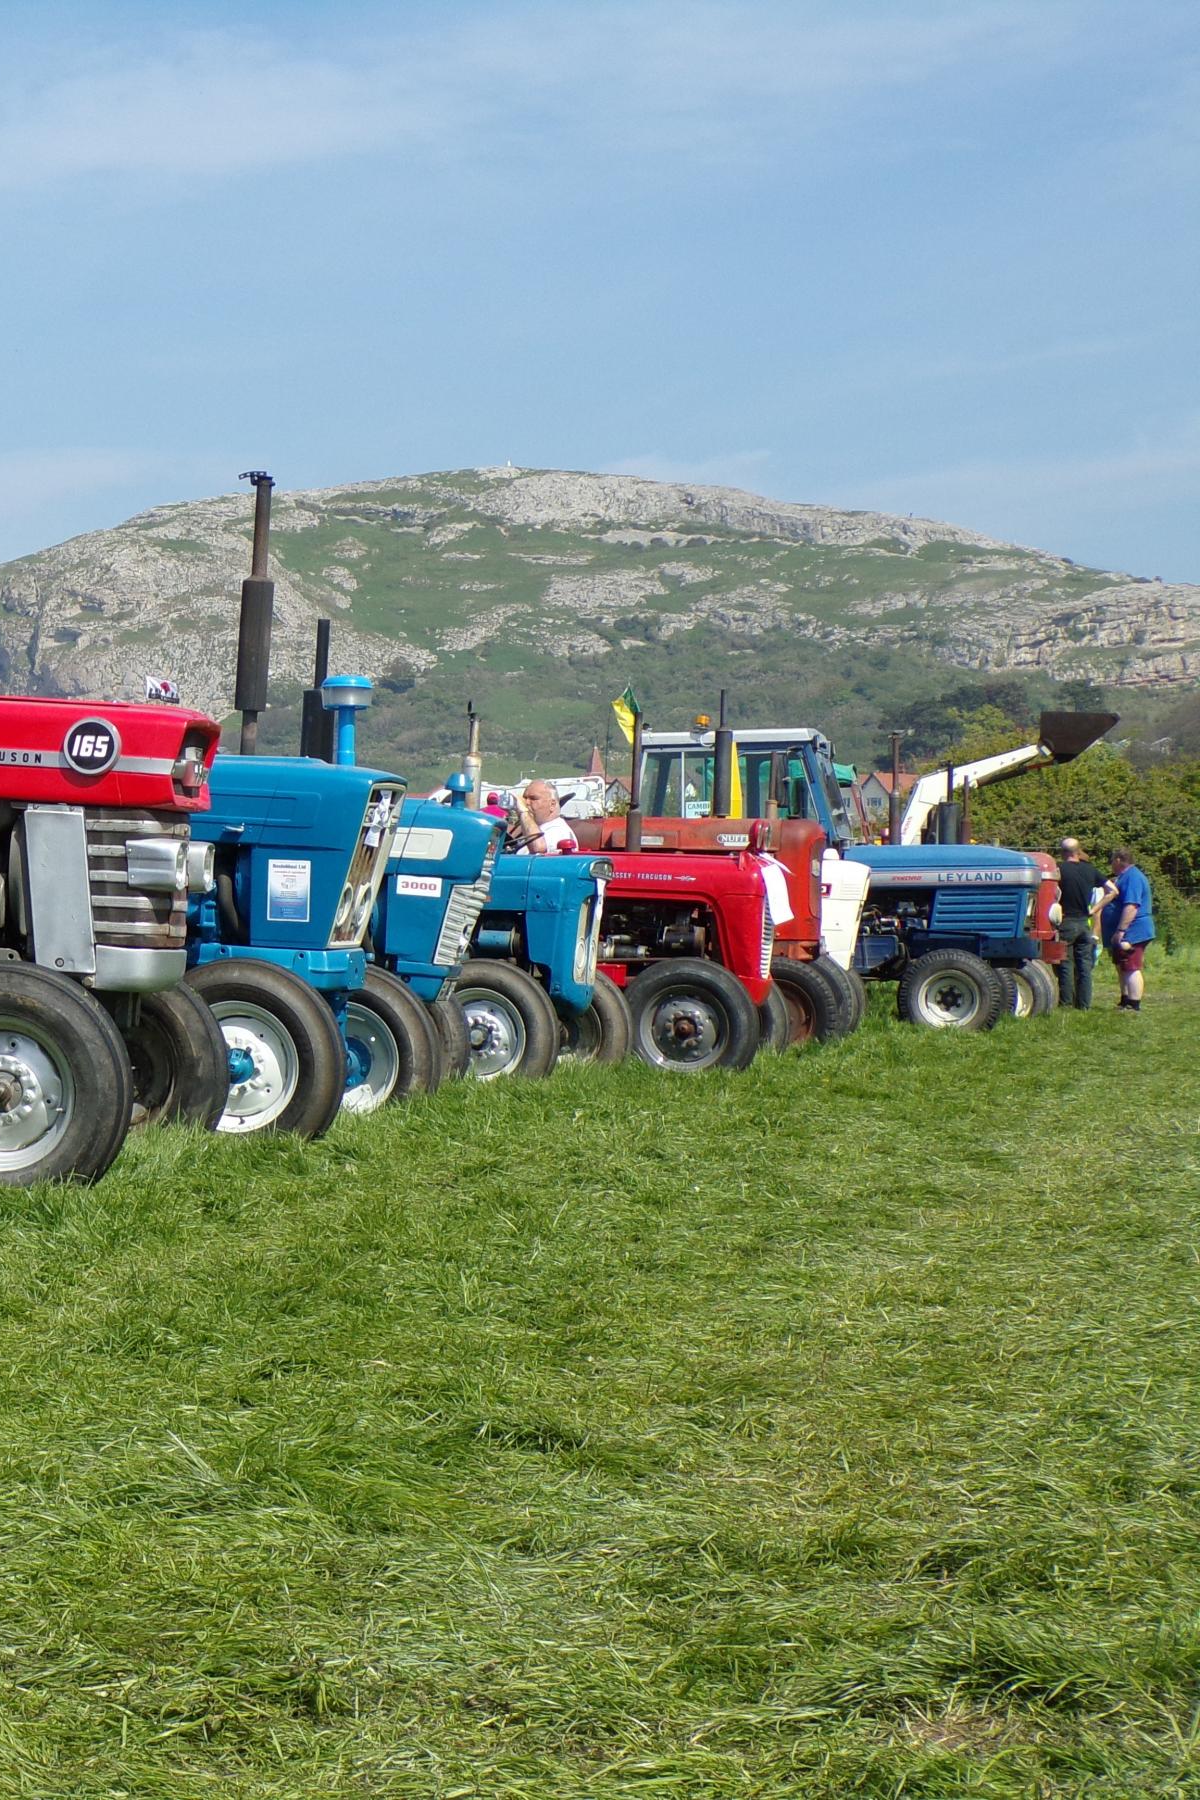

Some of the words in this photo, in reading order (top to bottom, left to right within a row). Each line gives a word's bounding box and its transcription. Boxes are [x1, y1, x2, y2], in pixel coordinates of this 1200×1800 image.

[71, 735, 110, 758] 165
[938, 872, 1003, 882] LEYLAND
[401, 881, 437, 891] 3000
